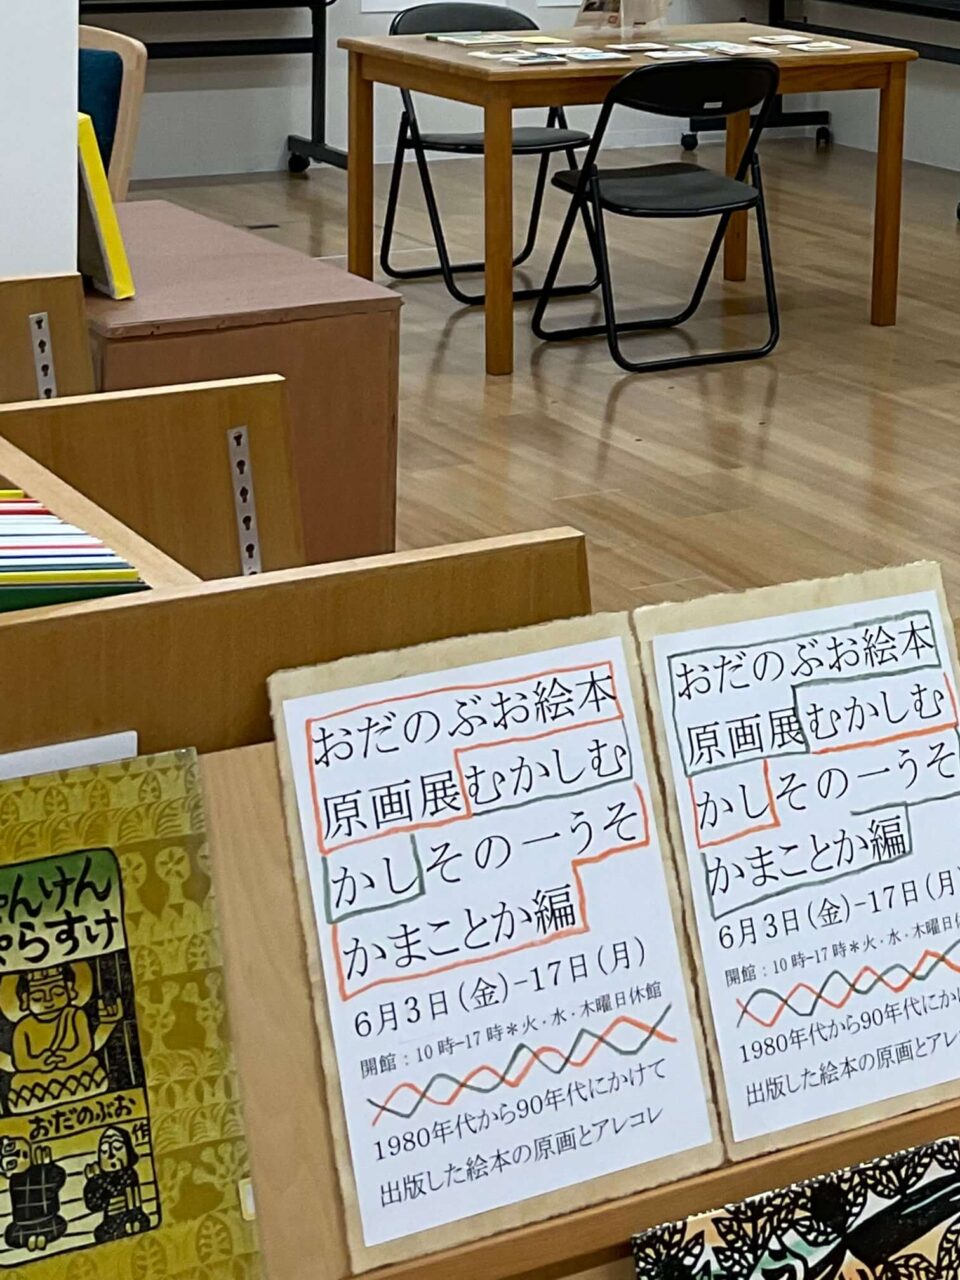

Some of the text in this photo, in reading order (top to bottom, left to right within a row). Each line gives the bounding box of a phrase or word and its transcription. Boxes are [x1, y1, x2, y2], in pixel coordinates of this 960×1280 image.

[677, 620, 936, 701] おだのぶお絵本
[313, 669, 618, 768] おだのぶお絵本
[687, 682, 946, 767] 原画展むかしむ
[322, 737, 628, 840] 原画展むかしむ
[0, 856, 112, 924] んけん
[707, 814, 907, 898] かまことか編
[342, 882, 577, 981] かまことか編
[28, 1094, 136, 1141] おだのぶお
[373, 1057, 667, 1162] 1980年代から90年代にかけて
[379, 1106, 664, 1208] 出版した絵本の原画とアレコレ
